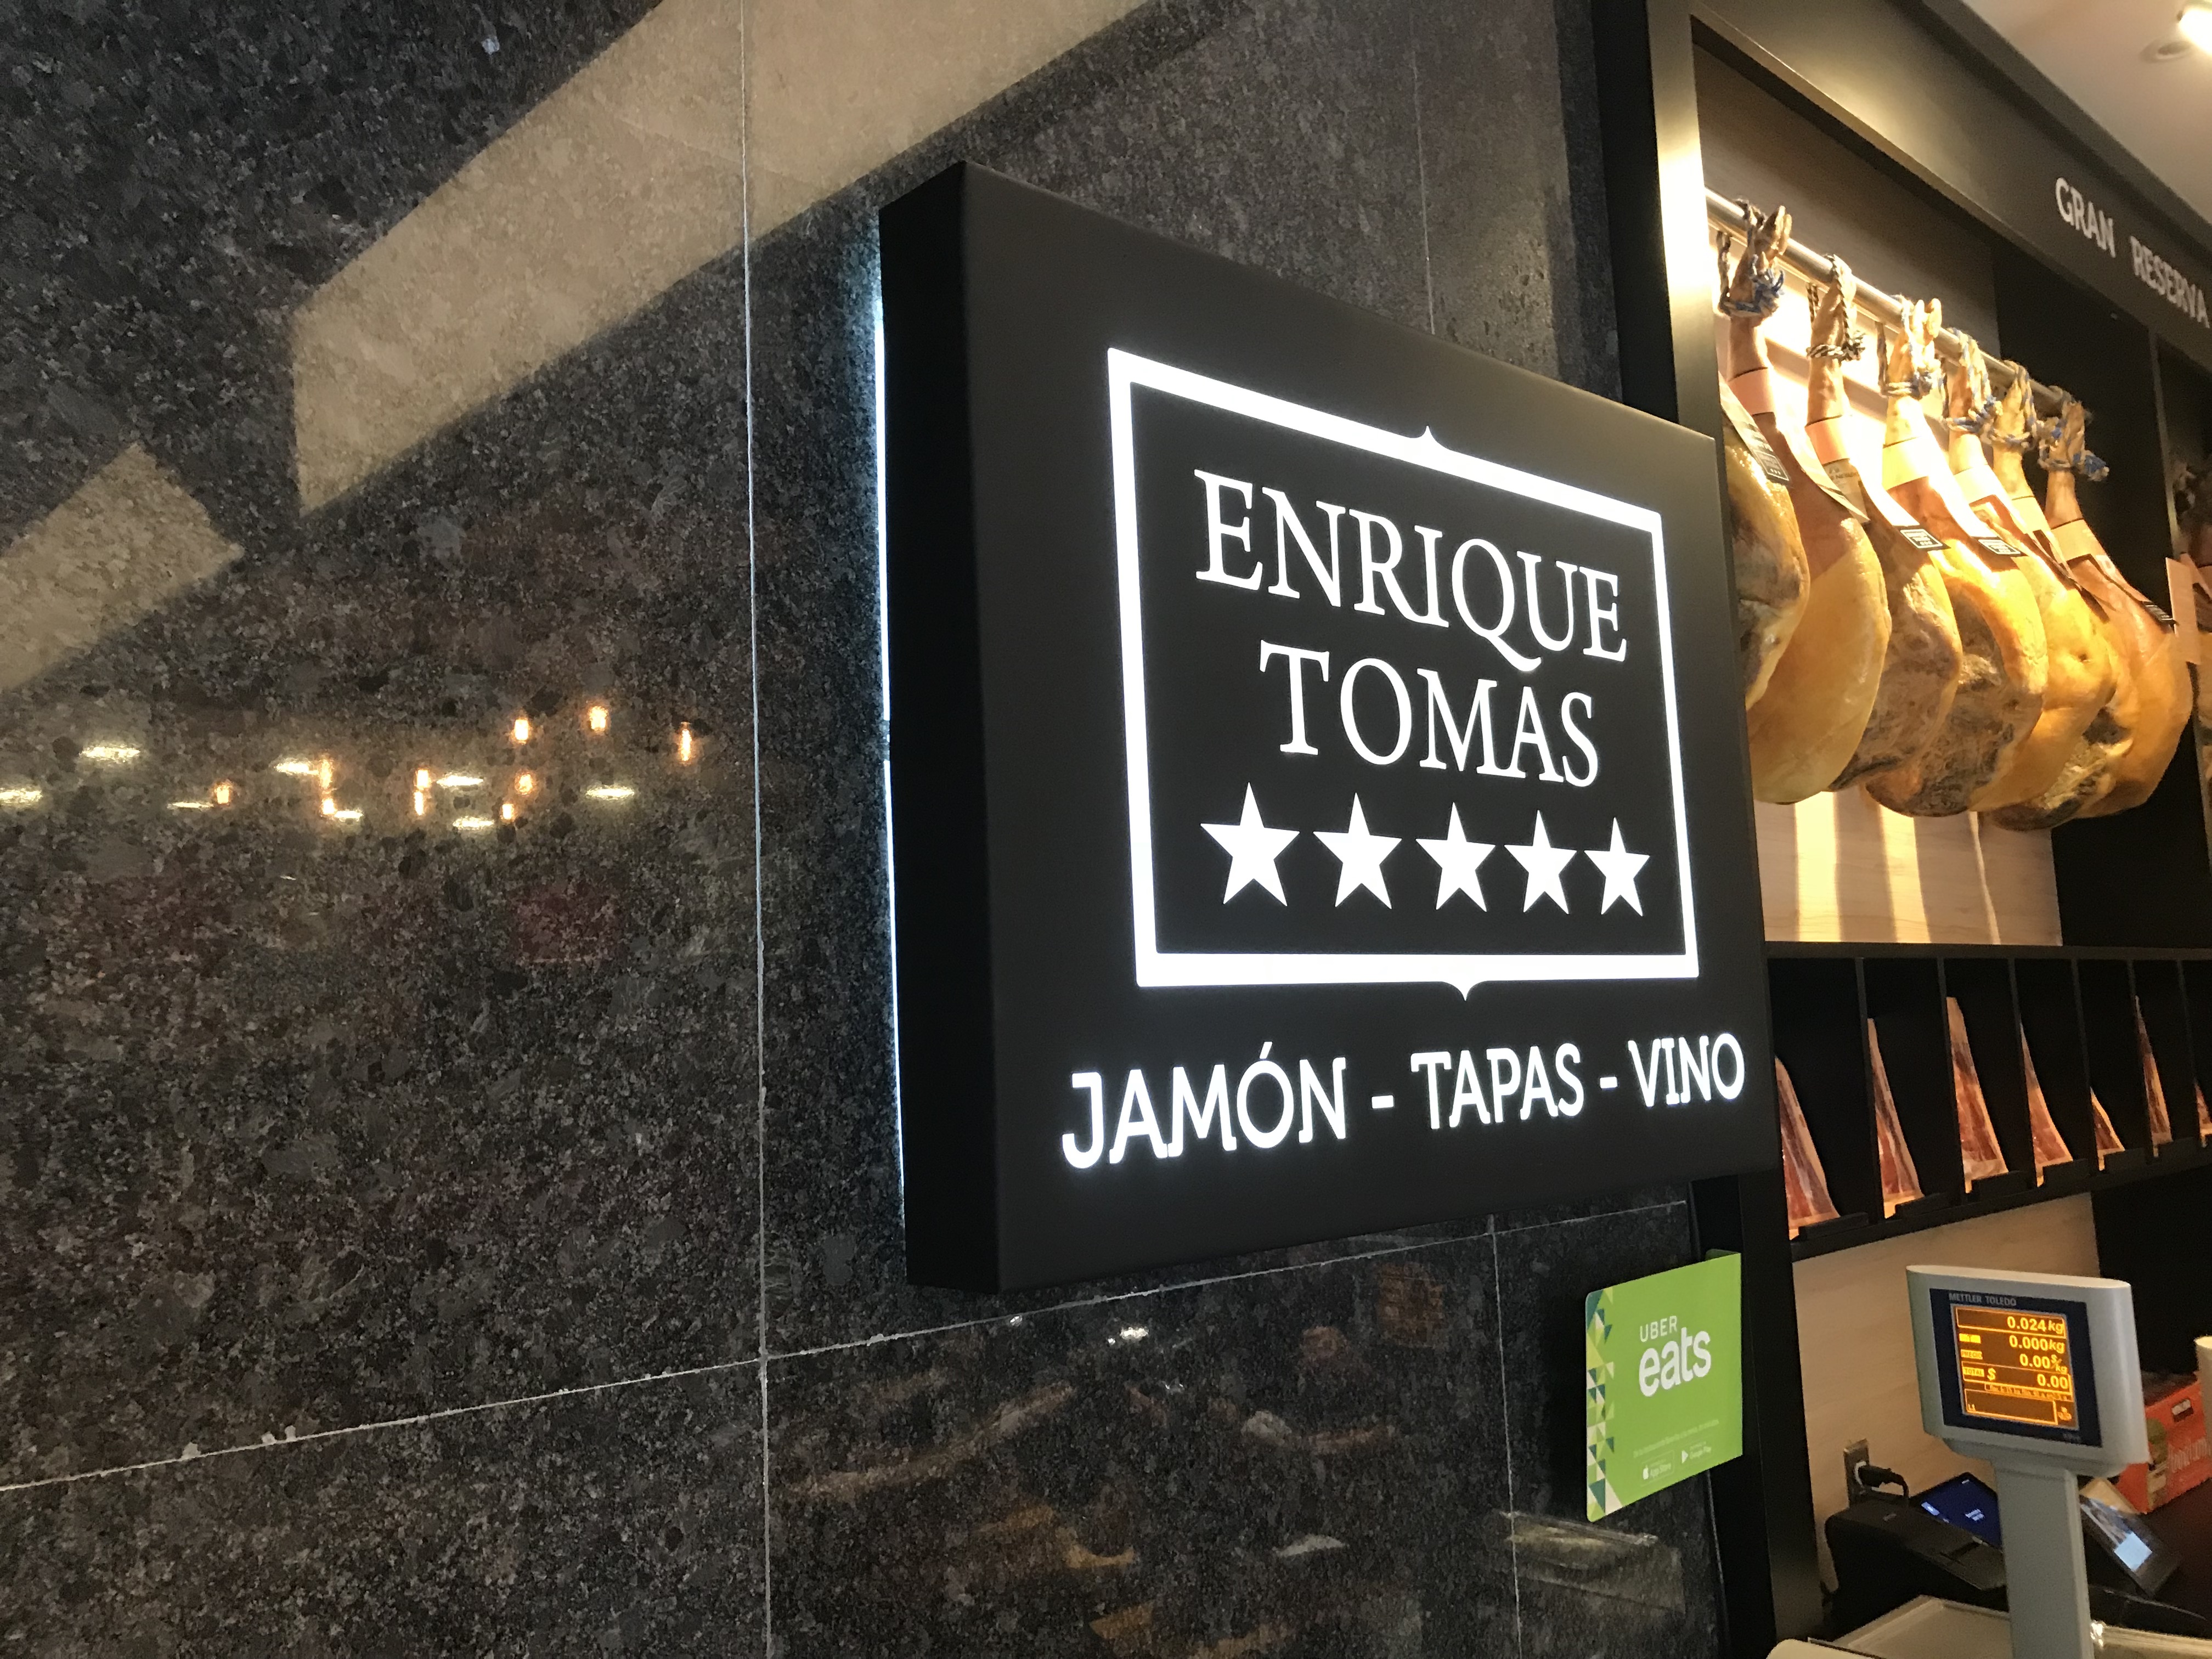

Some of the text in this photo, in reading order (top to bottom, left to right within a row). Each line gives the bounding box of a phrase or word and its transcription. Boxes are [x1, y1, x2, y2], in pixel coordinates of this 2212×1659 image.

[2056, 177, 2210, 329] GRAN RESERVA
[1194, 469, 1628, 673] ENRIQUE
[1260, 639, 1599, 787] TOMAS
[1062, 1041, 1348, 1171] JAMÓN
[1410, 1042, 1584, 1130] TAPAS
[1628, 1032, 1745, 1108] VINO
[1640, 1316, 1677, 1342] UBER
[1949, 1293, 2017, 1306] METTLER TOLEDO
[1639, 1327, 1711, 1397] eats
[1965, 1368, 1983, 1376] TOTAL
[2037, 1374, 2068, 1389] 0.00
